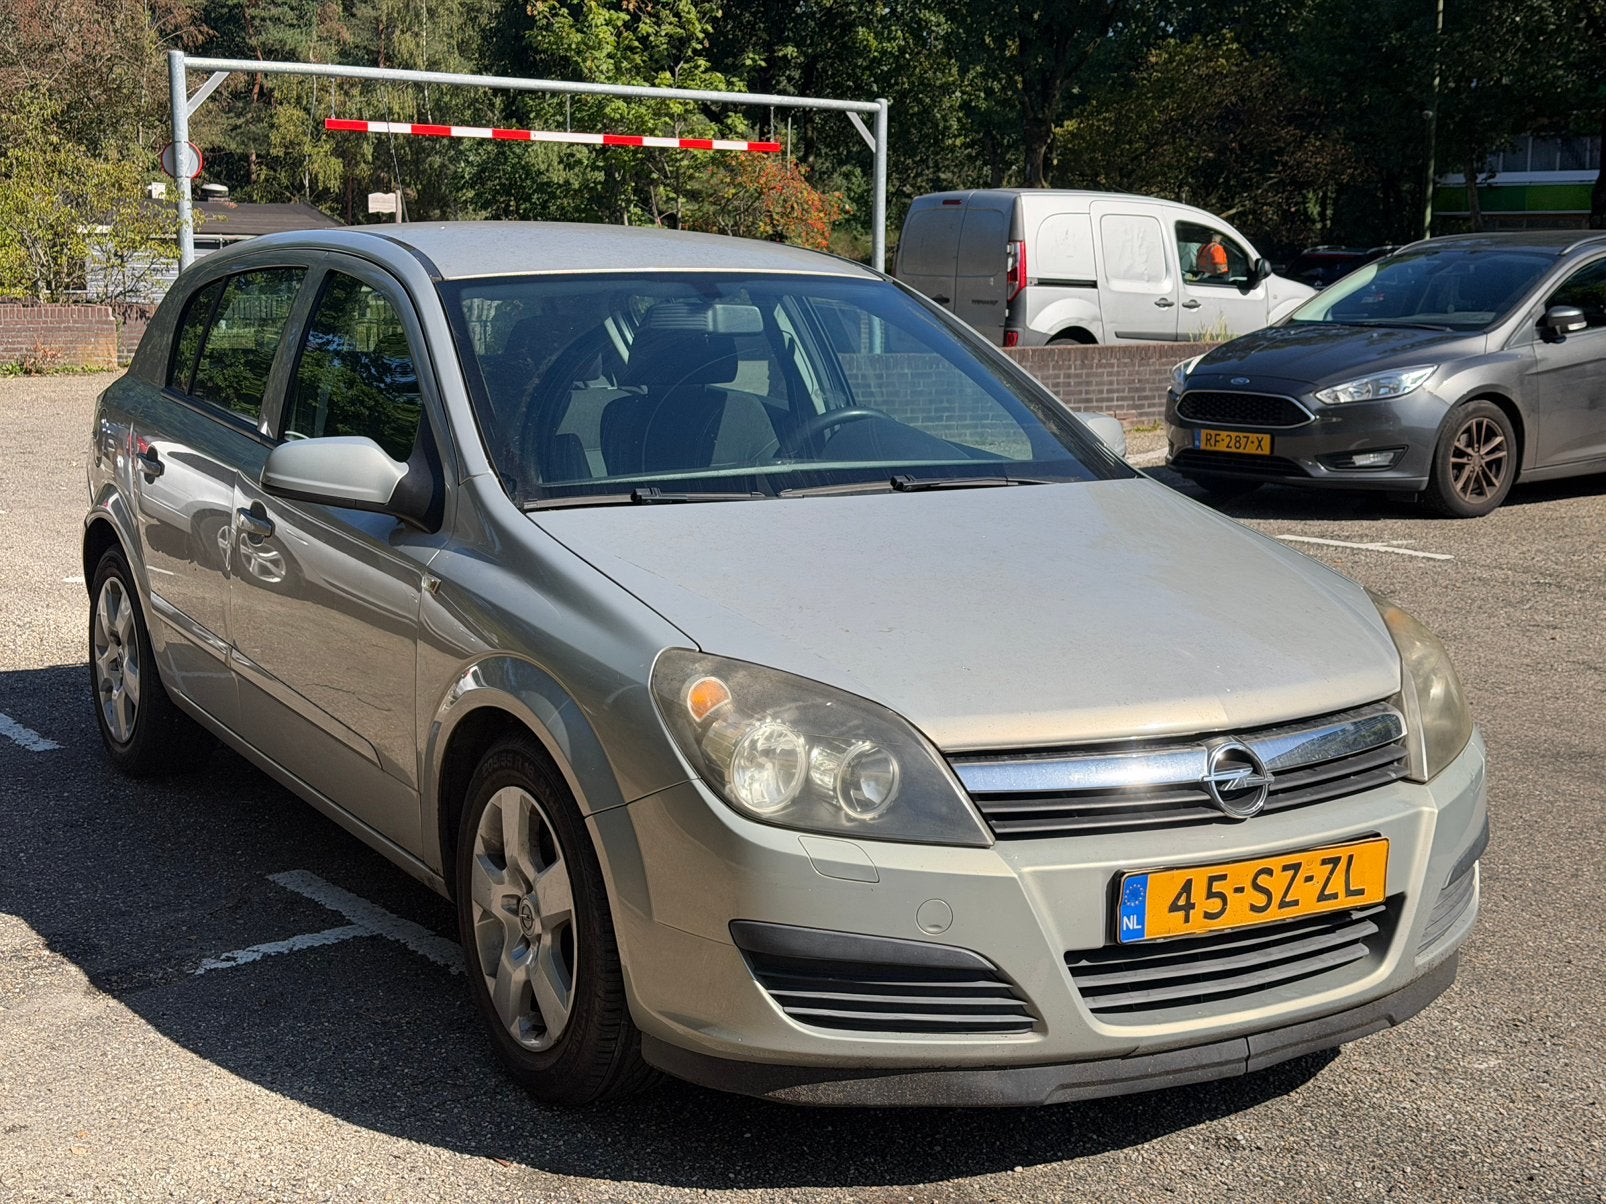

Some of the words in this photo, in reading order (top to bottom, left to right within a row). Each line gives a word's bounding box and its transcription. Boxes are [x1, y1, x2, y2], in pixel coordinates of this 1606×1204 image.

[1205, 432, 1264, 452] RF-287-X
[1168, 854, 1366, 924] 45-SZ-ZL
[1122, 914, 1142, 931] NL
